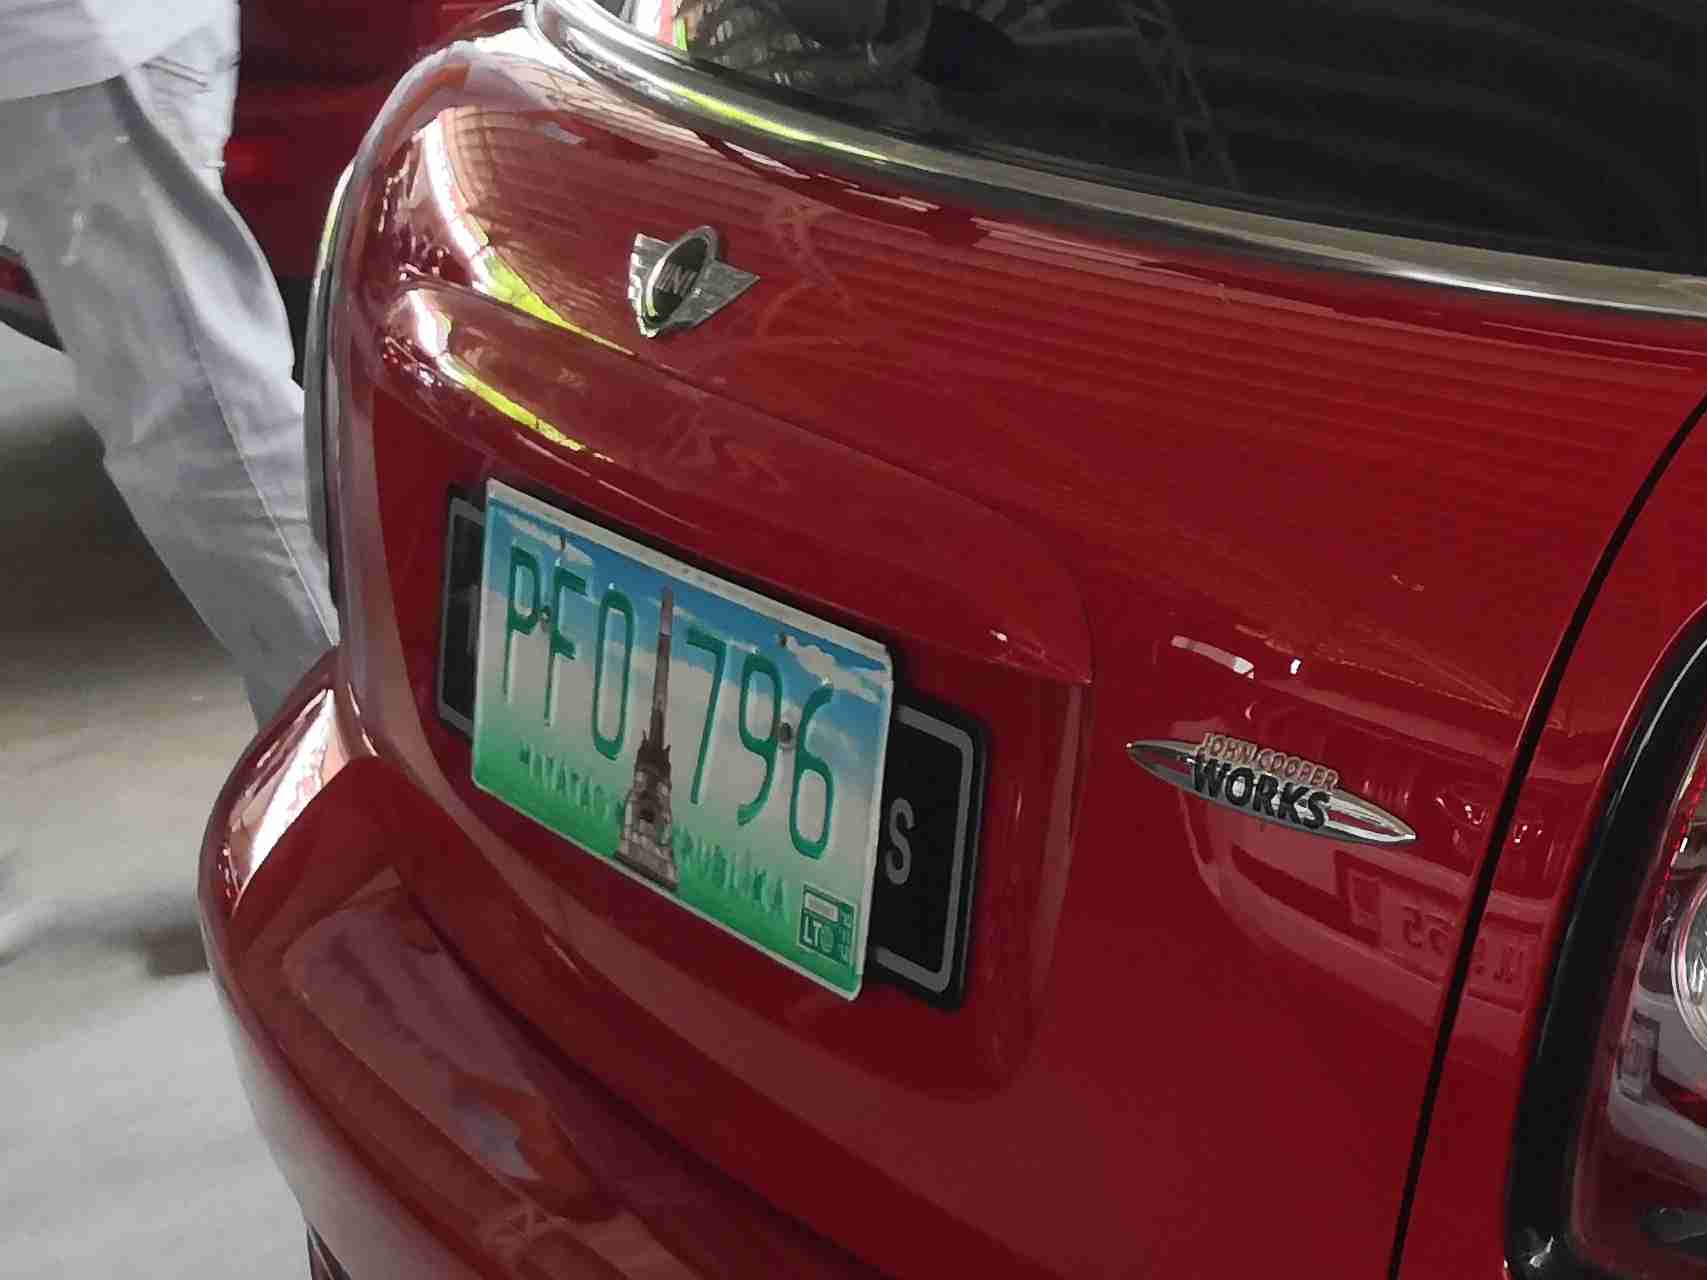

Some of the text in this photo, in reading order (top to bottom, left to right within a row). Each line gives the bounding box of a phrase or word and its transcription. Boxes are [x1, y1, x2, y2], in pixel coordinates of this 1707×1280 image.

[684, 623, 835, 860] 796
[1201, 732, 1338, 790] JOHN COOPER
[1193, 755, 1331, 829] WORKS
[885, 796, 917, 886] S
